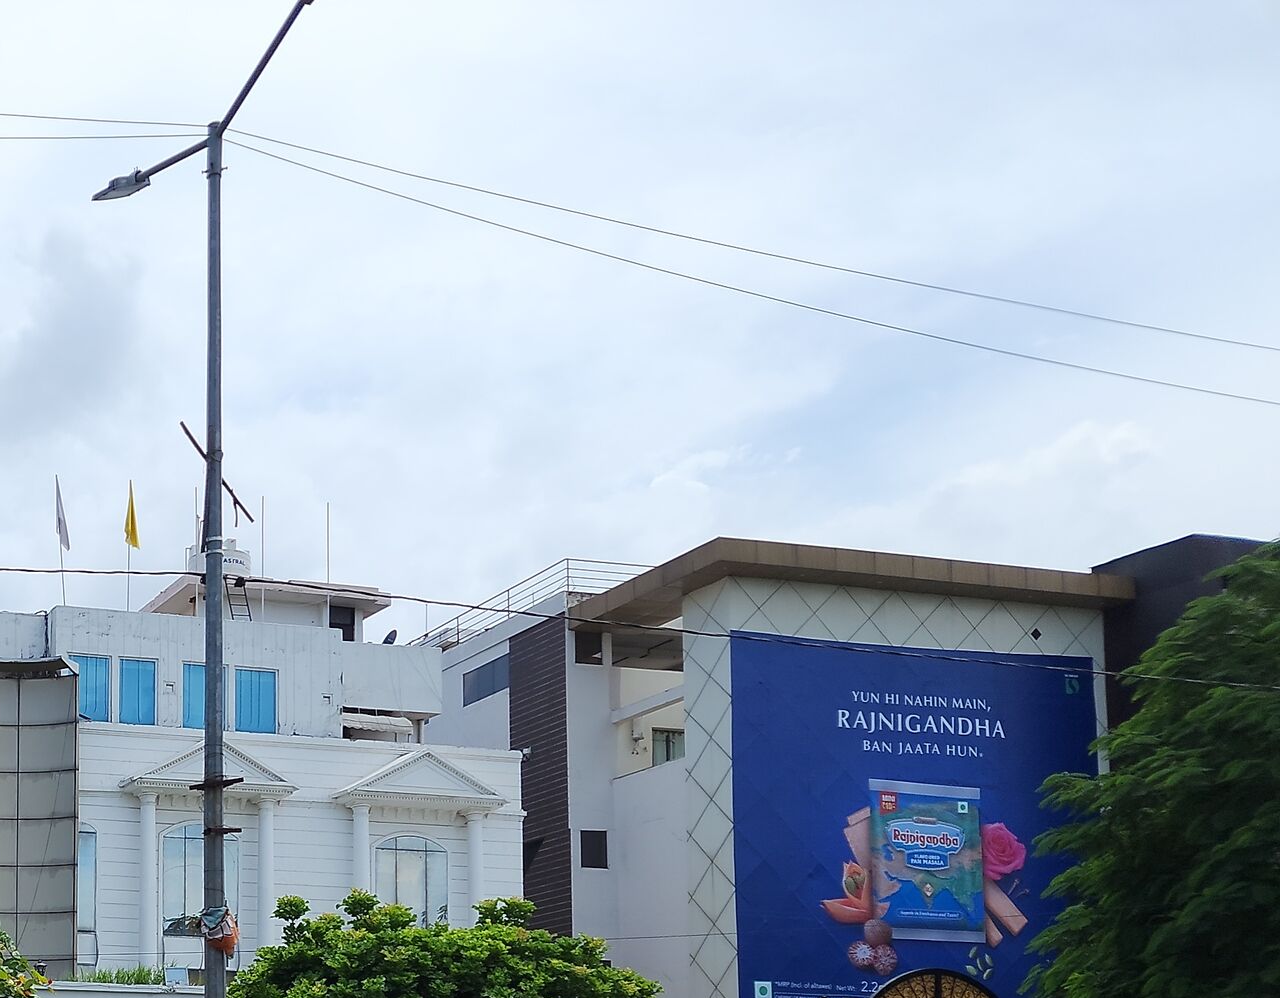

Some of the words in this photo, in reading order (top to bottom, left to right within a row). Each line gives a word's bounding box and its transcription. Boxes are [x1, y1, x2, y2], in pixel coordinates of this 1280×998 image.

[223, 558, 246, 566] ASTRAL
[852, 690, 880, 704] YUN
[885, 693, 899, 705] HI
[904, 695, 947, 708] NAHIN
[952, 697, 991, 712] MAIN,
[838, 709, 1005, 738] RAJNIGANDHA
[863, 740, 891, 753] BAN
[899, 742, 940, 755] JAATA
[946, 744, 983, 757] HUN.
[892, 828, 959, 848] Rajnigandha
